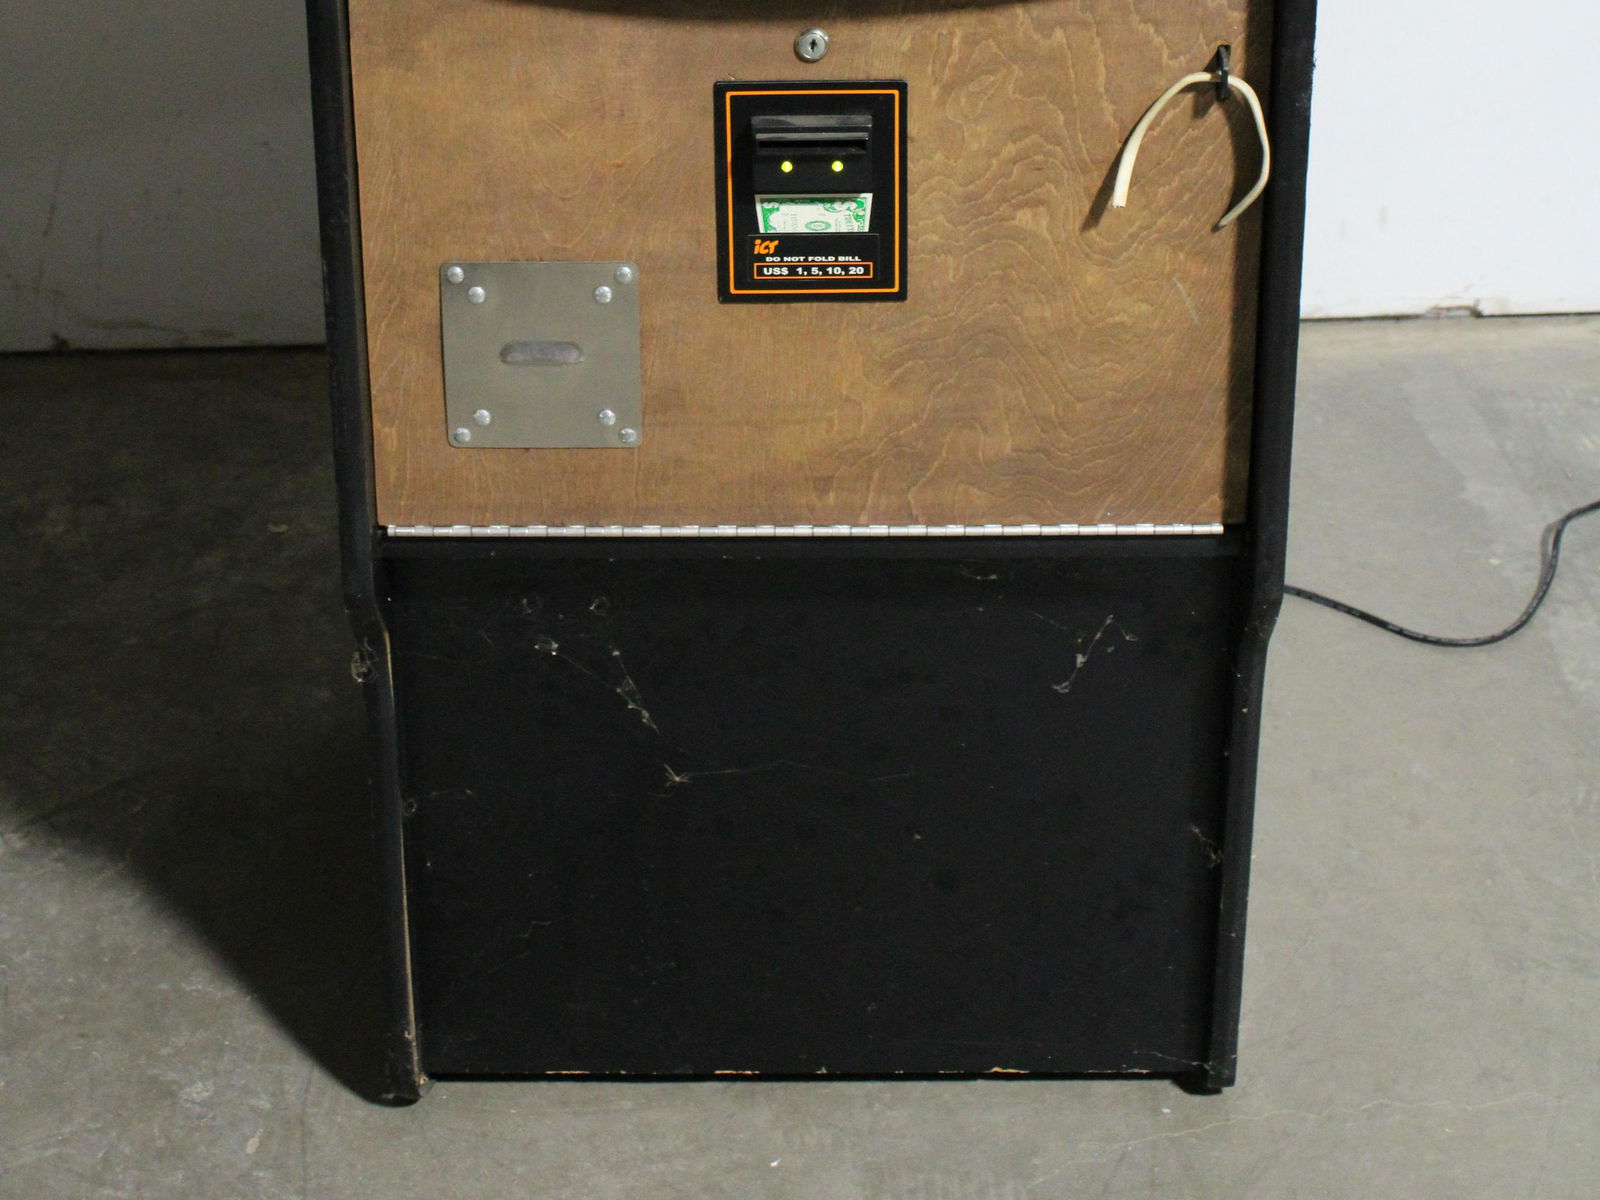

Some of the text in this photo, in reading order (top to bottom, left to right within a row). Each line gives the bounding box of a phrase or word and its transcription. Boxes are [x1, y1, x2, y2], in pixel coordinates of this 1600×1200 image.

[796, 267, 807, 276] 1,
[811, 267, 823, 276] 5,
[826, 267, 845, 276] 10,
[848, 266, 864, 275] 20
